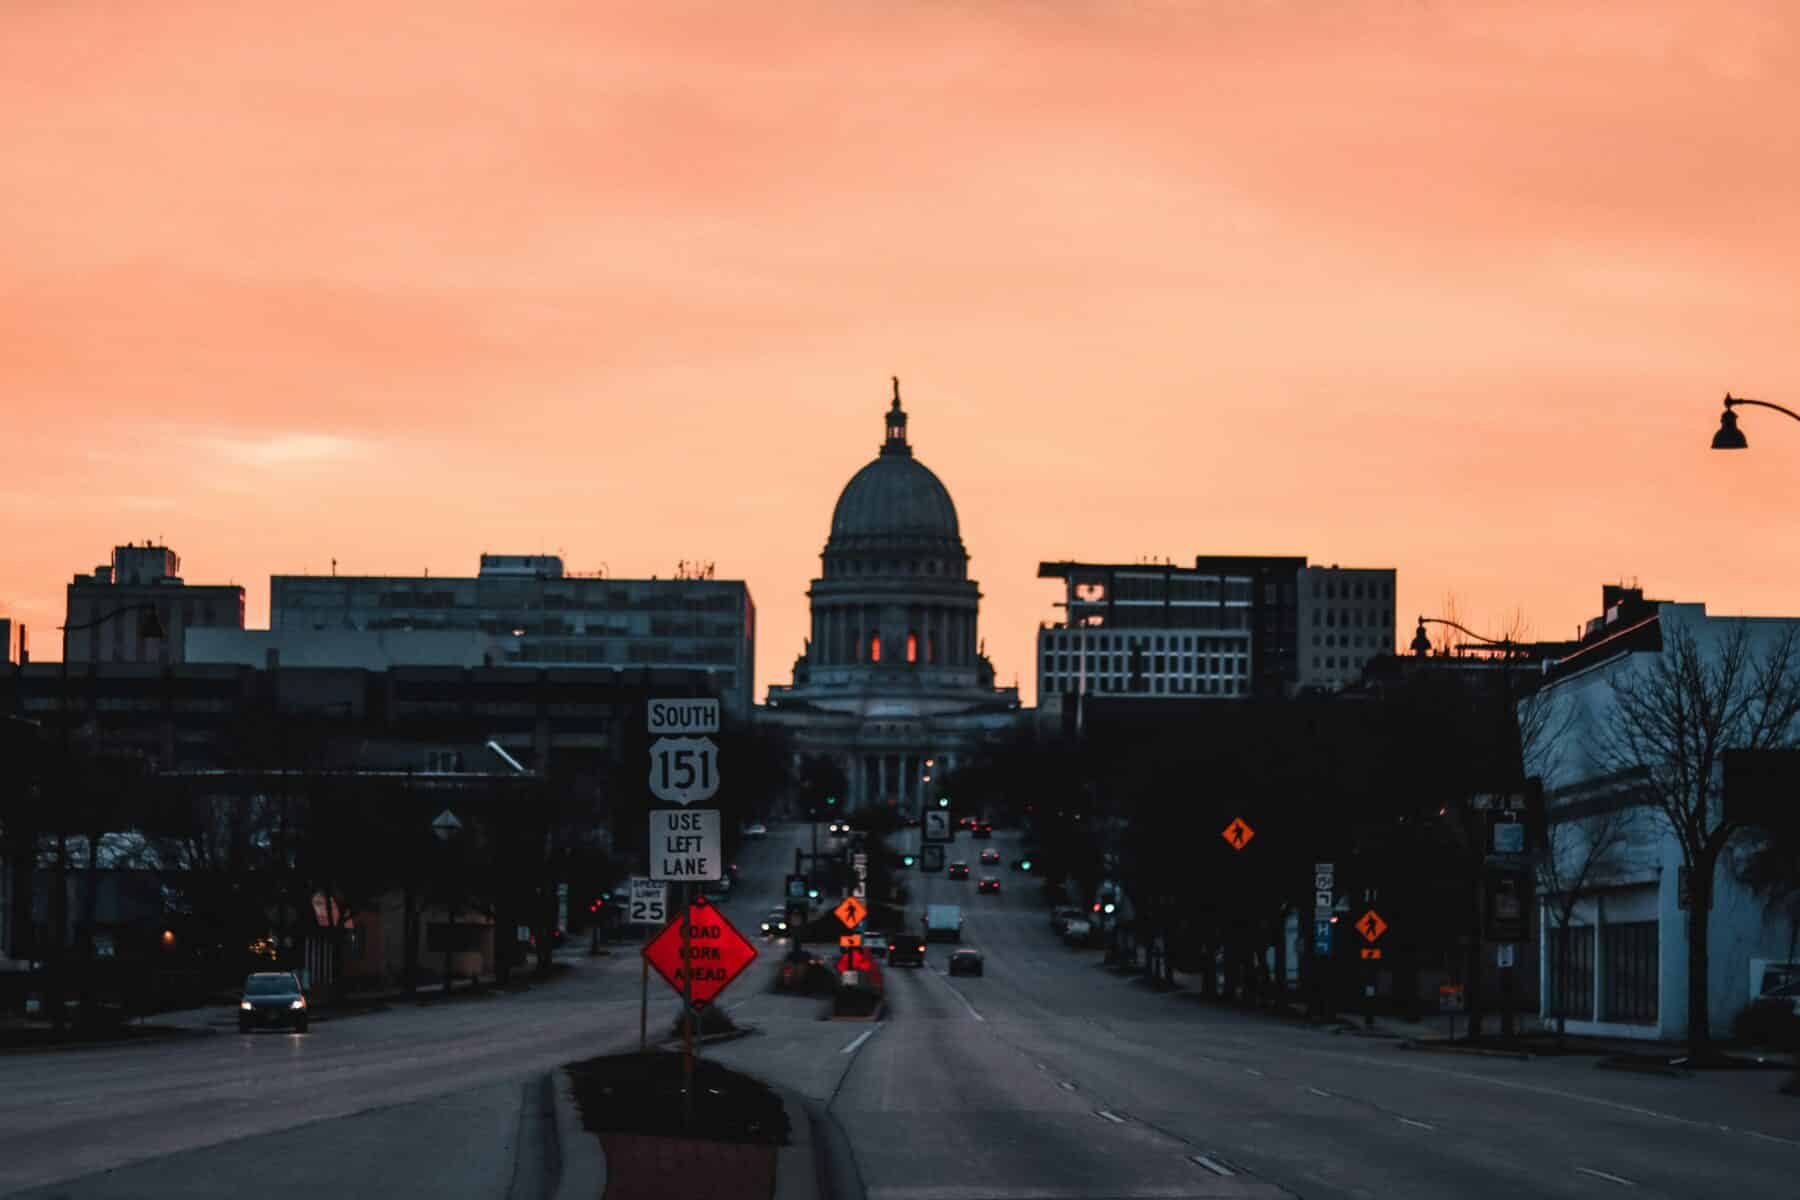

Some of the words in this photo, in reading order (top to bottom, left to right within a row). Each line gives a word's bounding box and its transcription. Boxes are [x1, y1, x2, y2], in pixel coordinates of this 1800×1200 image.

[652, 704, 716, 727] SOUTH
[659, 751, 710, 790] 151
[668, 814, 702, 831] USE
[667, 837, 704, 853] LEFT
[664, 858, 707, 876] LANE
[632, 902, 663, 920] 25
[675, 967, 728, 980] AEAD
